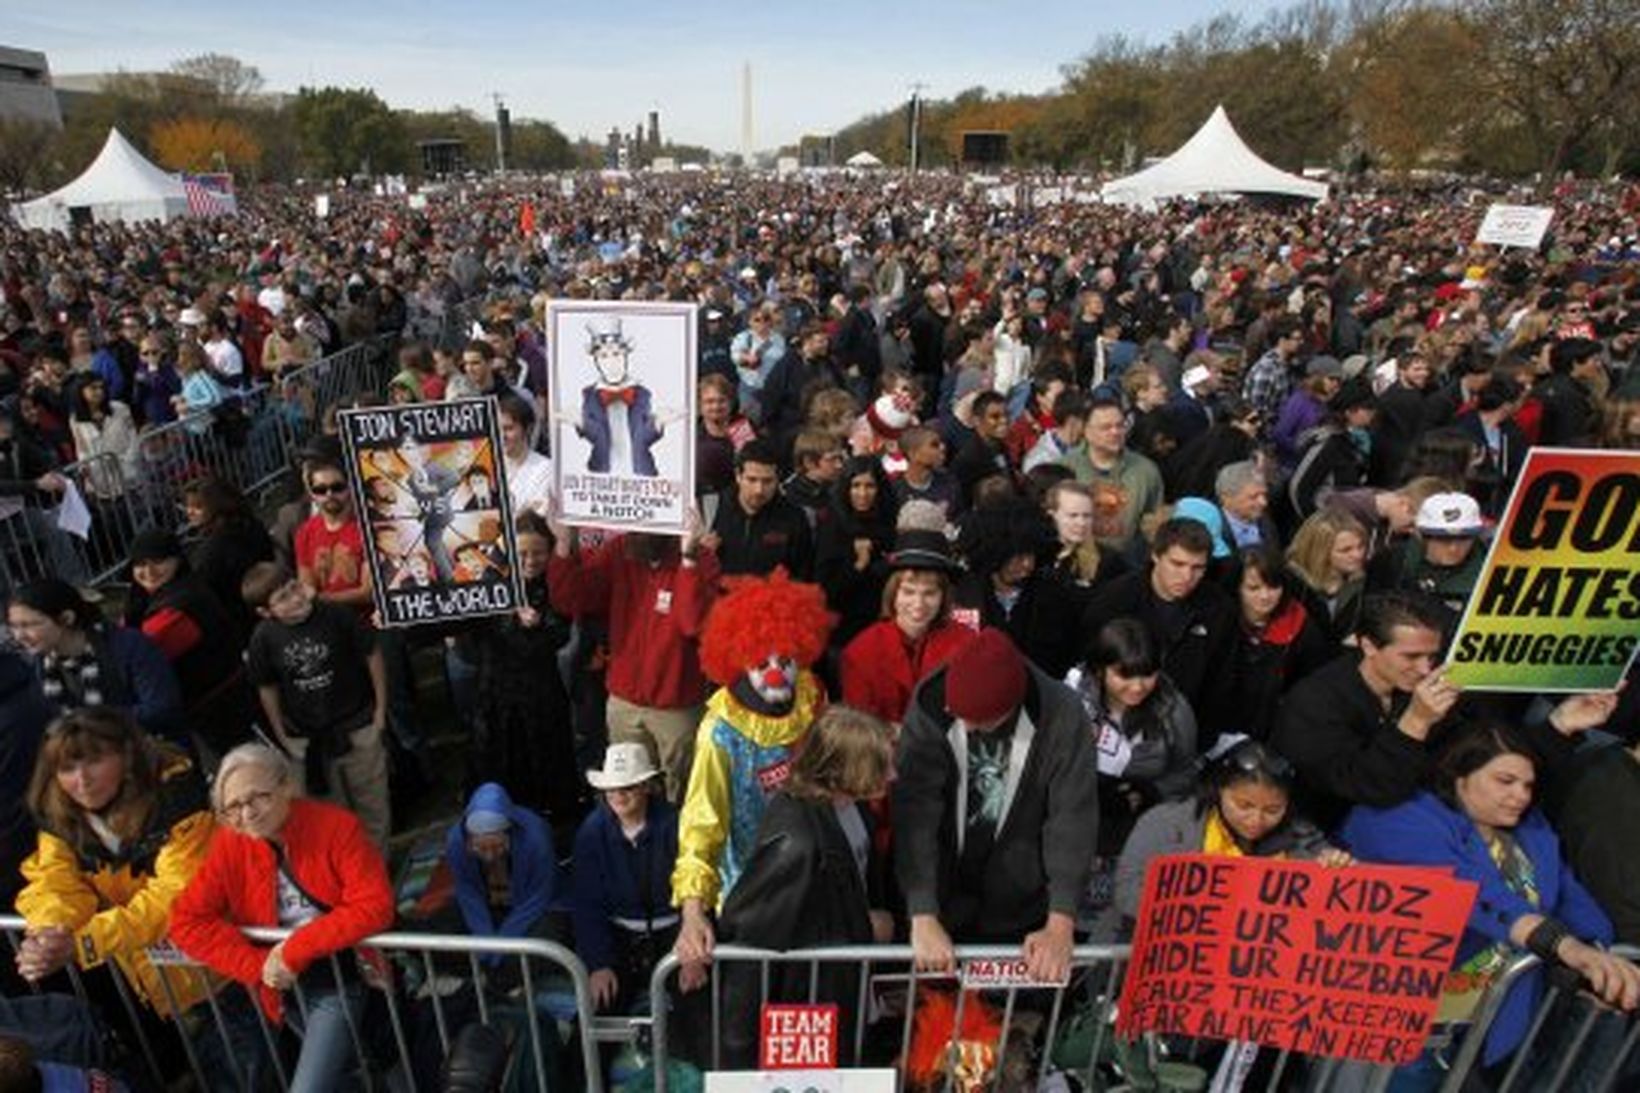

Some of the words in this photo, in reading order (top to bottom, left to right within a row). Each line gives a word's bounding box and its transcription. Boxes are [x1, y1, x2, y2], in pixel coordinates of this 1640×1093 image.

[354, 412, 397, 443] JON
[401, 402, 485, 437] STEWART
[1509, 469, 1640, 552] GO
[390, 592, 434, 620] THE
[436, 583, 510, 615] WORLD
[1454, 631, 1637, 666] SNUGGIES
[1155, 861, 1236, 901] HIDE
[1259, 869, 1310, 909] UR
[1326, 876, 1431, 919] KIDZ
[1148, 904, 1222, 941] HIDE
[1236, 909, 1293, 948] UR
[1315, 919, 1455, 962] WIVEZ
[969, 962, 1029, 977] NATIO
[1139, 942, 1218, 979] HIDE
[1229, 945, 1279, 979] UR
[1296, 953, 1445, 999] HUZBAN
[767, 1010, 832, 1033] TEAM
[1132, 979, 1215, 1005] CAUZ
[1229, 983, 1315, 1014] THEY
[1317, 997, 1428, 1033] KEEPIN
[766, 1035, 830, 1065] FEAR
[1129, 1003, 1191, 1039] FEAR
[1198, 1008, 1288, 1045] ALIVE
[1312, 1025, 1338, 1056] IN
[1344, 1030, 1420, 1063] HERE
